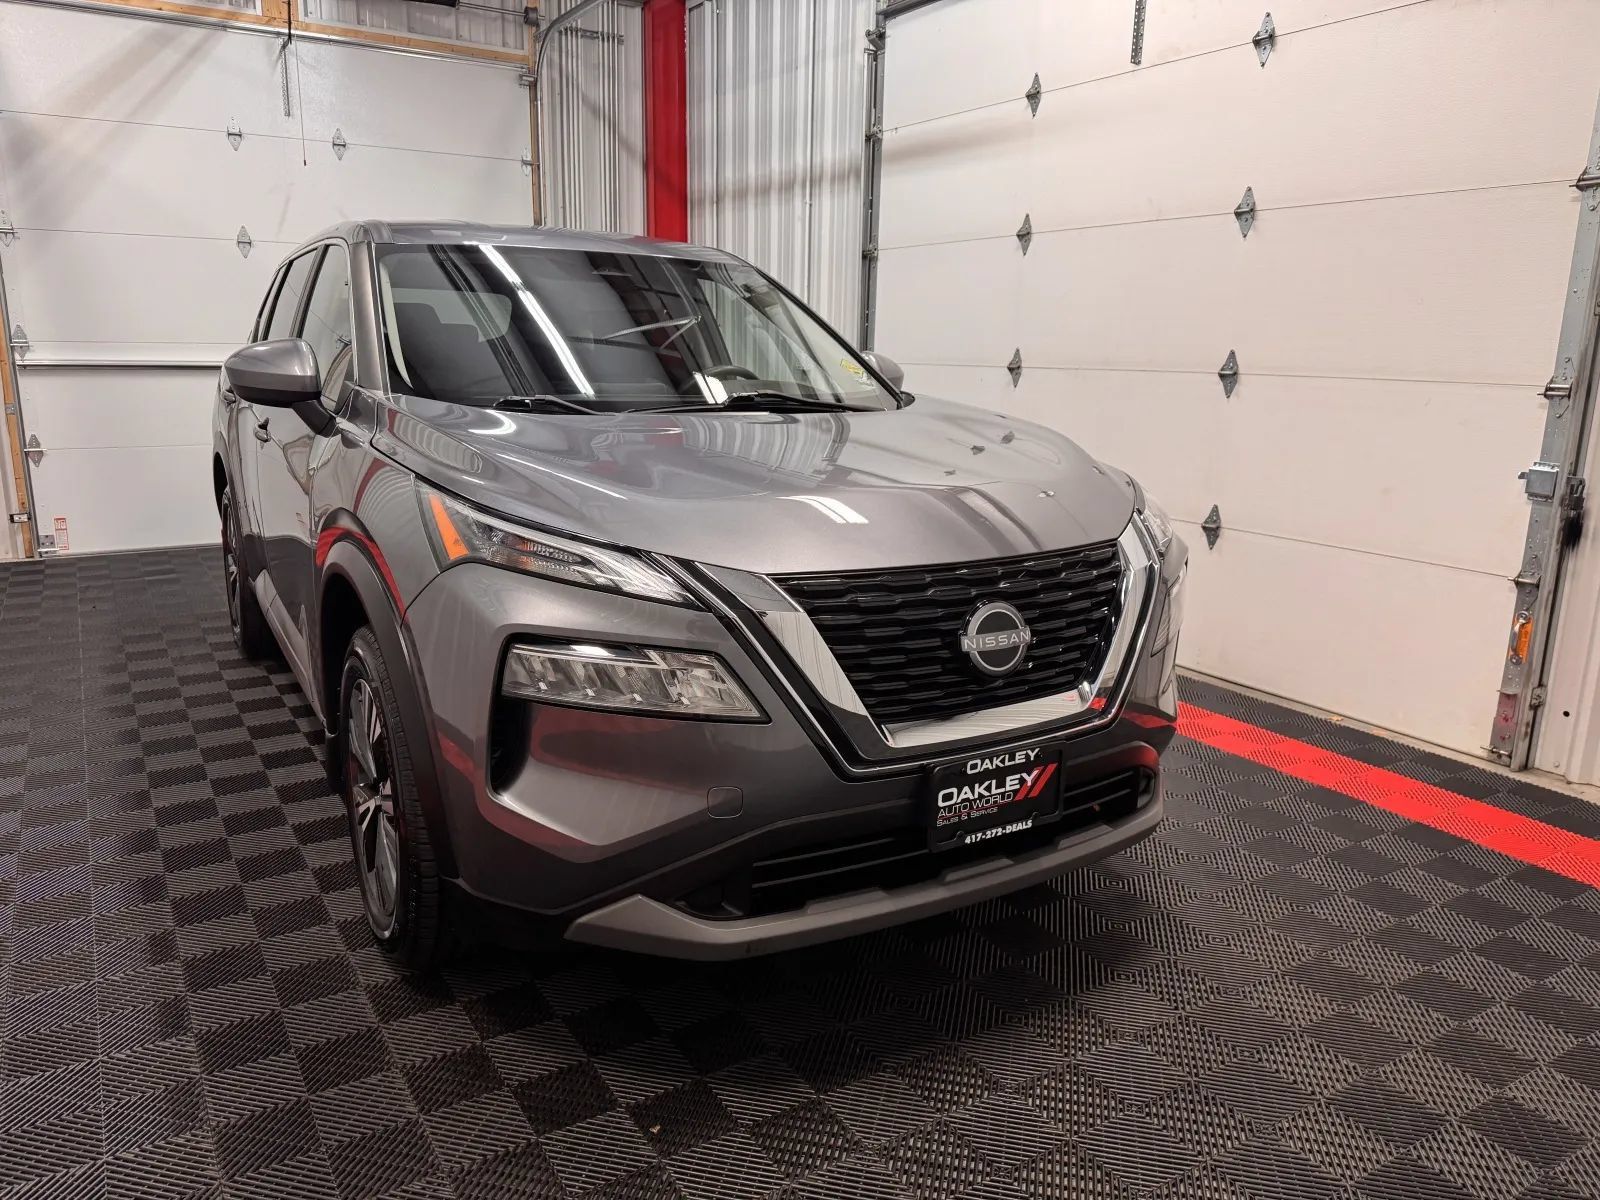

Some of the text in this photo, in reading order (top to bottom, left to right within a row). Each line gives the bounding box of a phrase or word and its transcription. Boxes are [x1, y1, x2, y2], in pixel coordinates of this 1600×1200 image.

[964, 631, 1029, 649] NISSAN
[967, 748, 1040, 774] OAKLEY
[937, 770, 1040, 807] OAKLEY
[938, 792, 1014, 818] AUTO WORLD
[964, 820, 1033, 844] 417-272-DEALS
